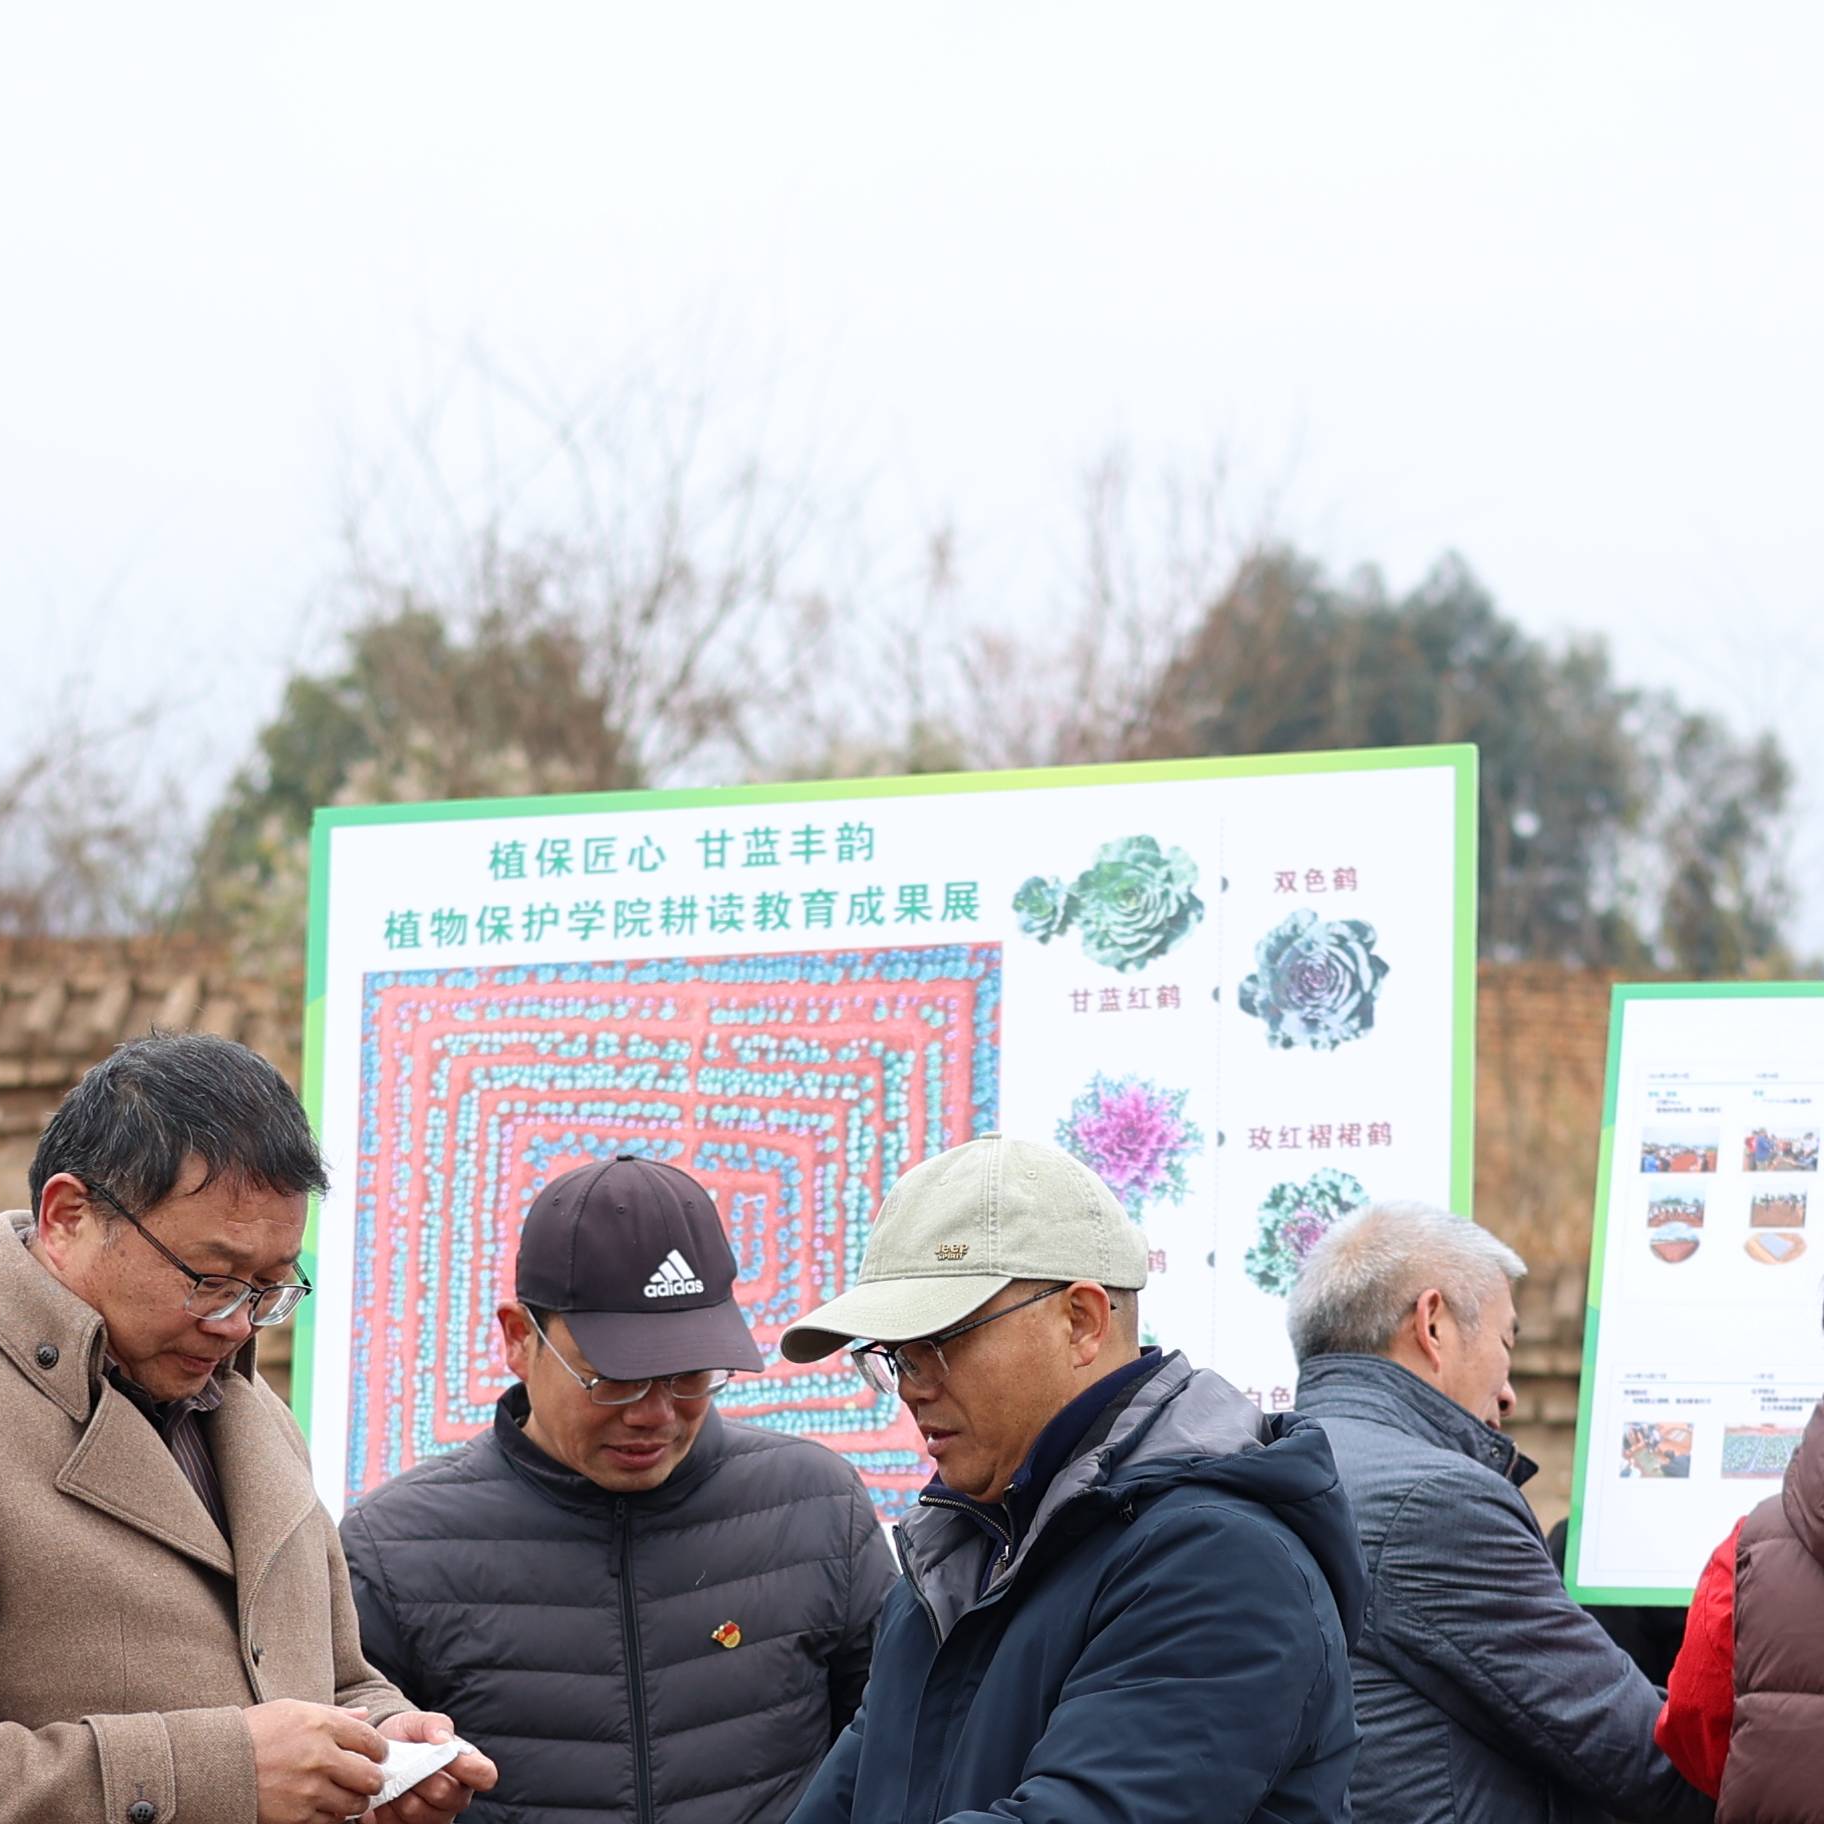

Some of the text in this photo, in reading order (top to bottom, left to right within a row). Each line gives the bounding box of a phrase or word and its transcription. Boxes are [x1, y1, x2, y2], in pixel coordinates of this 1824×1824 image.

[488, 820, 876, 882] 植保匠心 甘蓝丰韵
[1273, 866, 1358, 893] 双色鹤
[383, 880, 982, 952] 植物保护学院耕读教育成果展
[1069, 984, 1182, 1013] 甘蓝红鹤
[1247, 1121, 1393, 1151] 玫红褶裙鹤
[935, 1240, 969, 1254] Jeep
[643, 1277, 705, 1298] adidas
